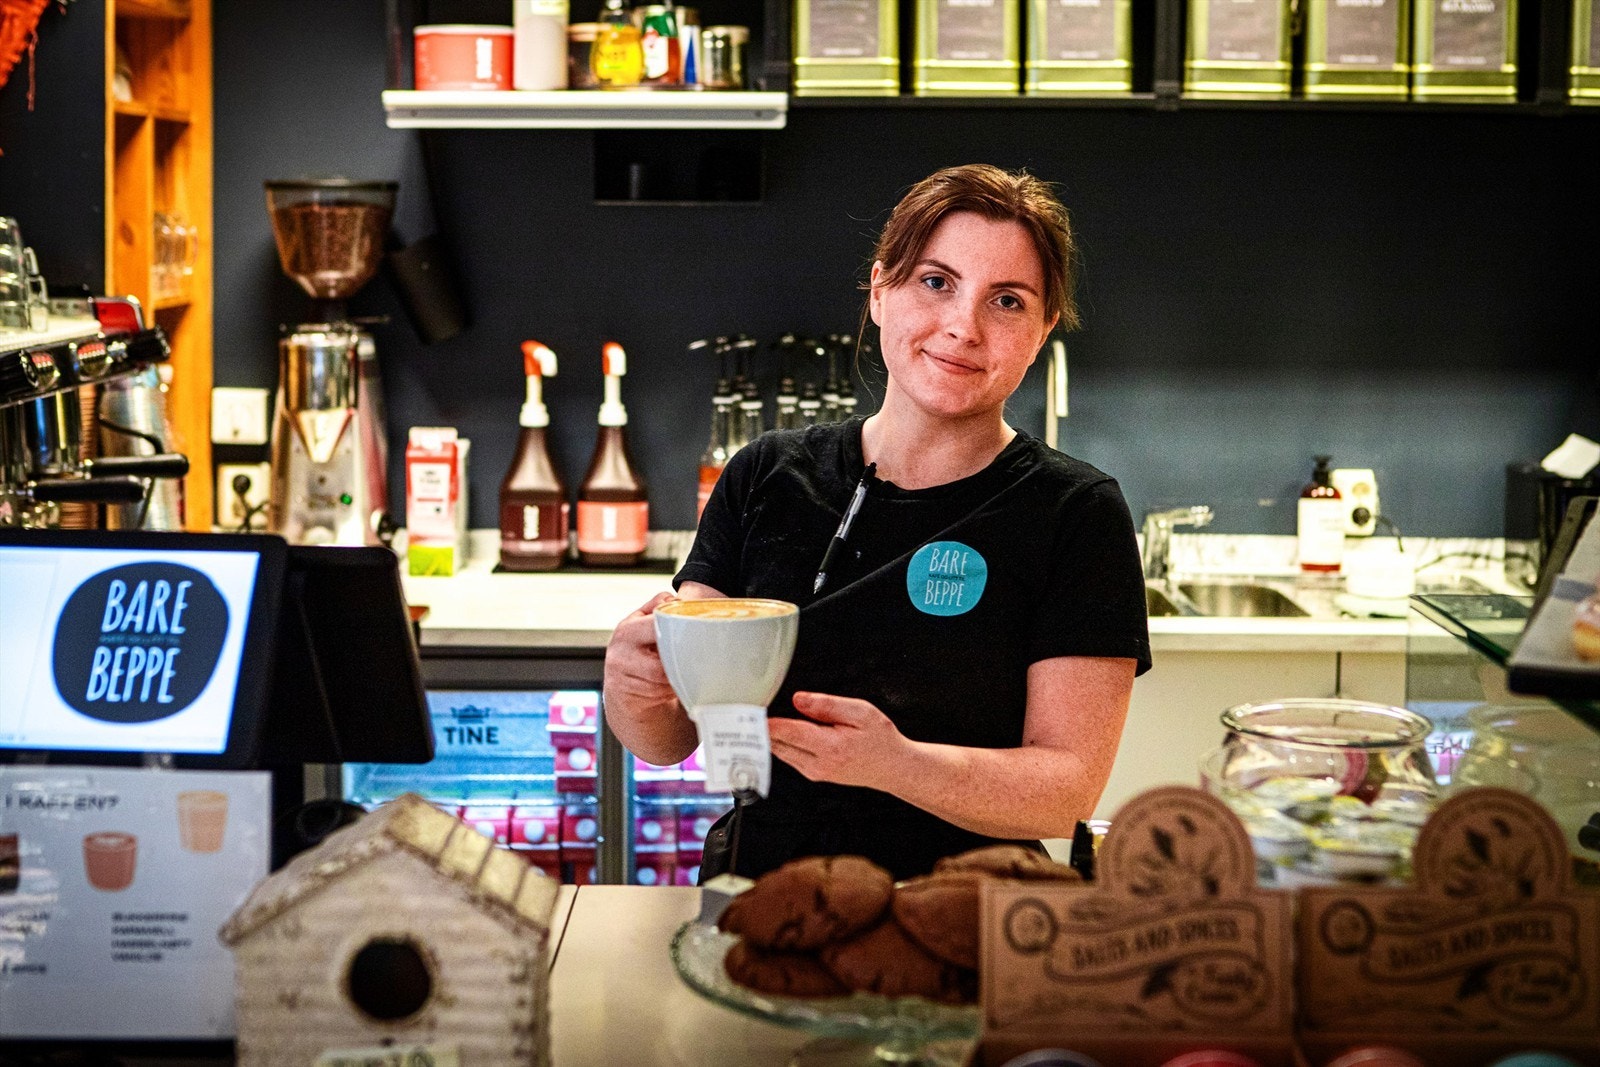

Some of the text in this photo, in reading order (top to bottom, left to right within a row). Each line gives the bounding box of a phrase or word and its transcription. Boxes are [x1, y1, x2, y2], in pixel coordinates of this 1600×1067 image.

[929, 548, 969, 576] BARE
[101, 579, 193, 634] BARE
[924, 579, 965, 607] BEPPE
[86, 645, 181, 703] BEPPE
[443, 726, 499, 745] TINE
